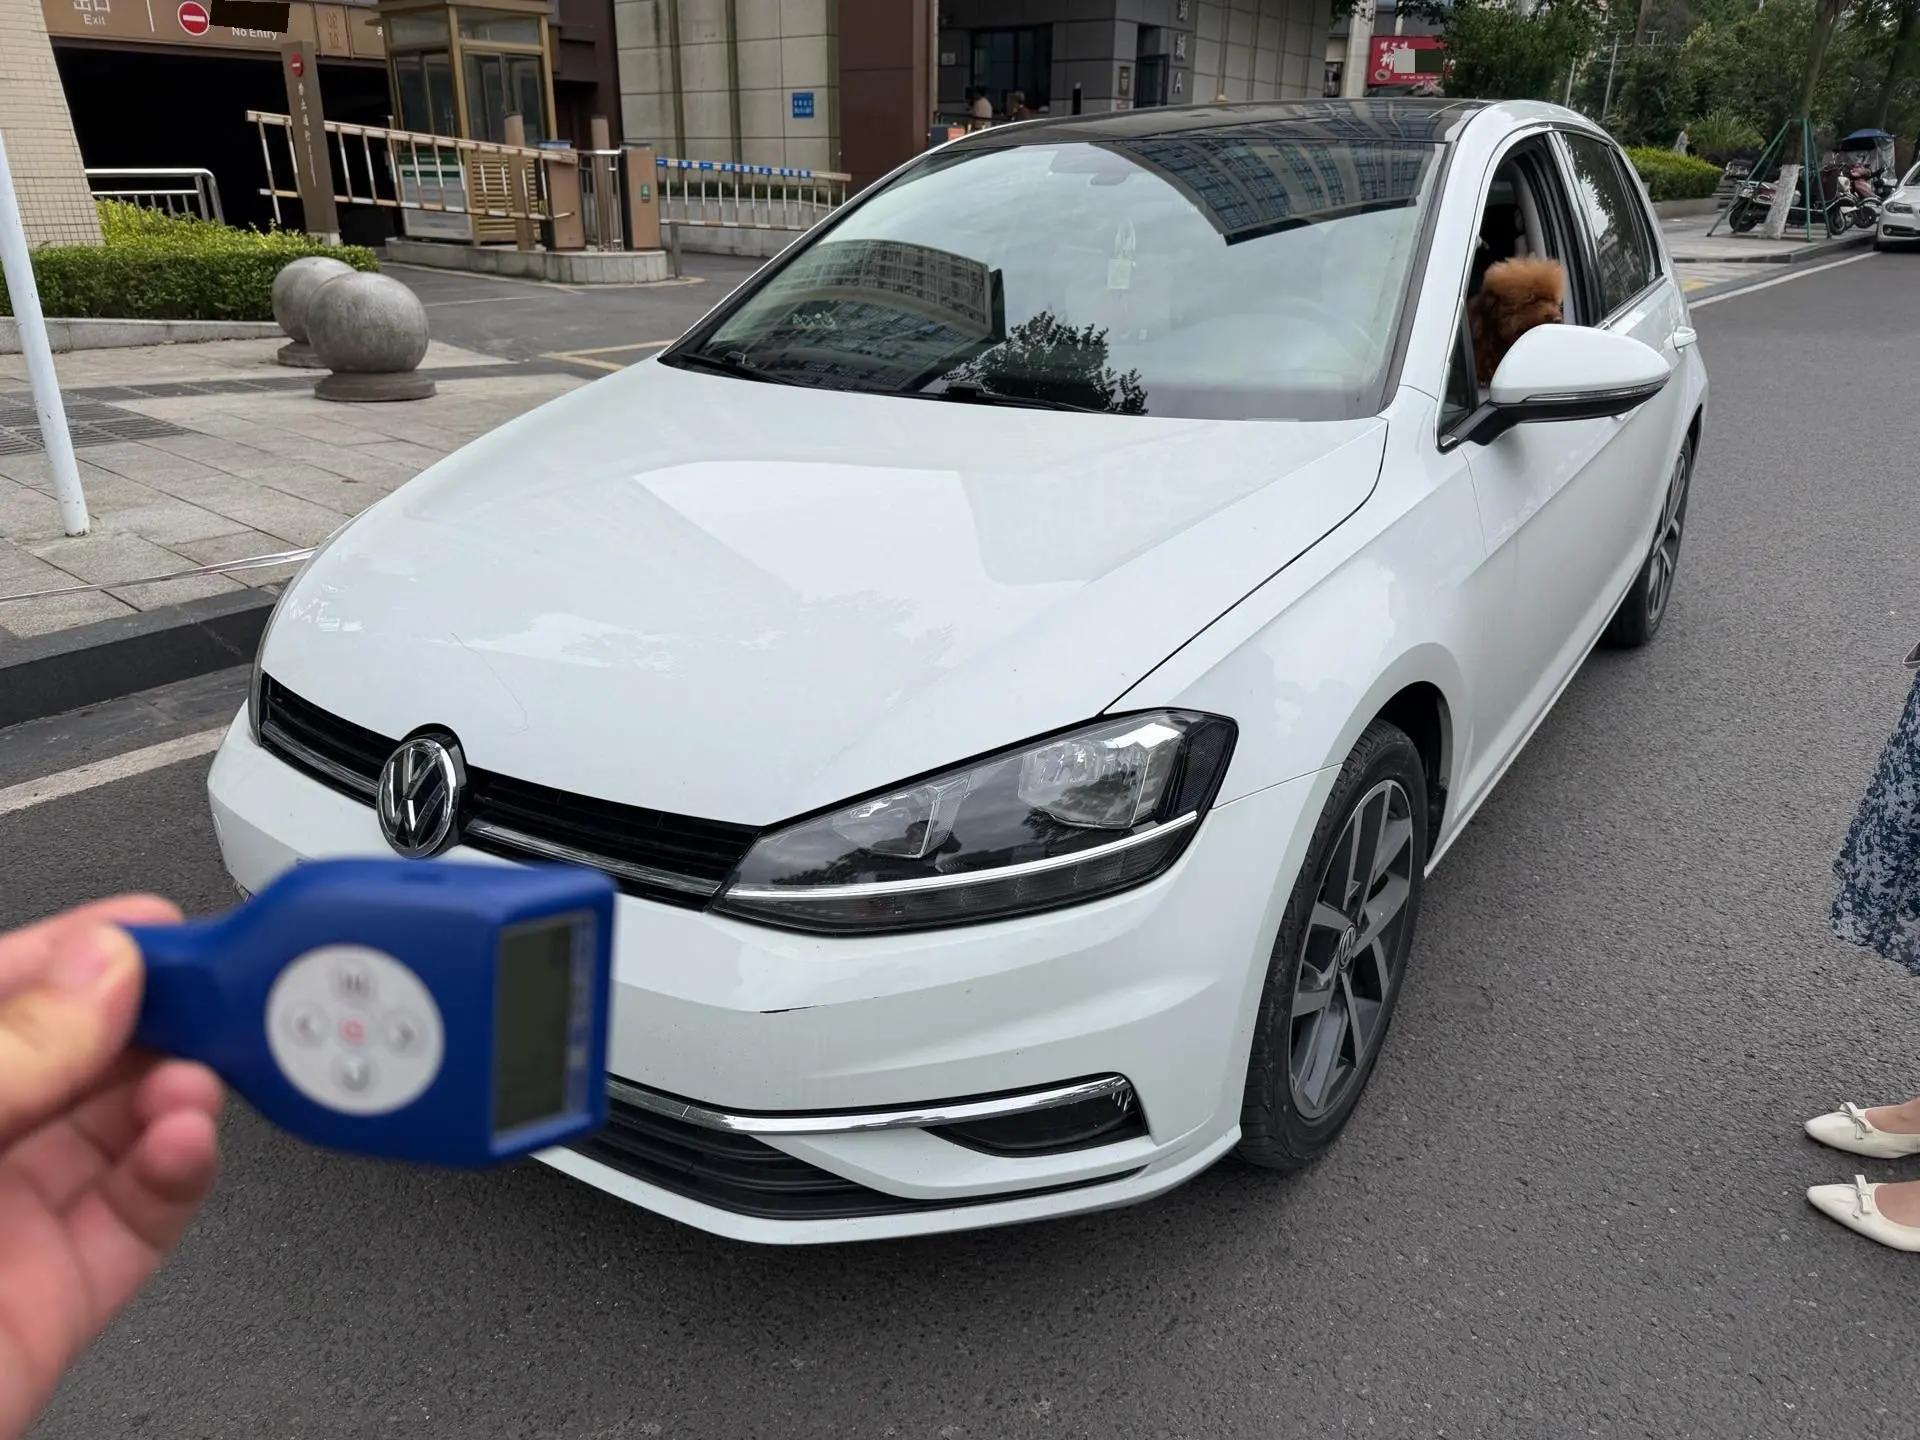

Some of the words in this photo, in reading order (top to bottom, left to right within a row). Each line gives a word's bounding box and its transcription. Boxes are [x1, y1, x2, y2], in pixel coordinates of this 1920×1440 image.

[83, 14, 106, 25] Exit
[231, 26, 247, 37] No
[249, 28, 277, 40] Entry
